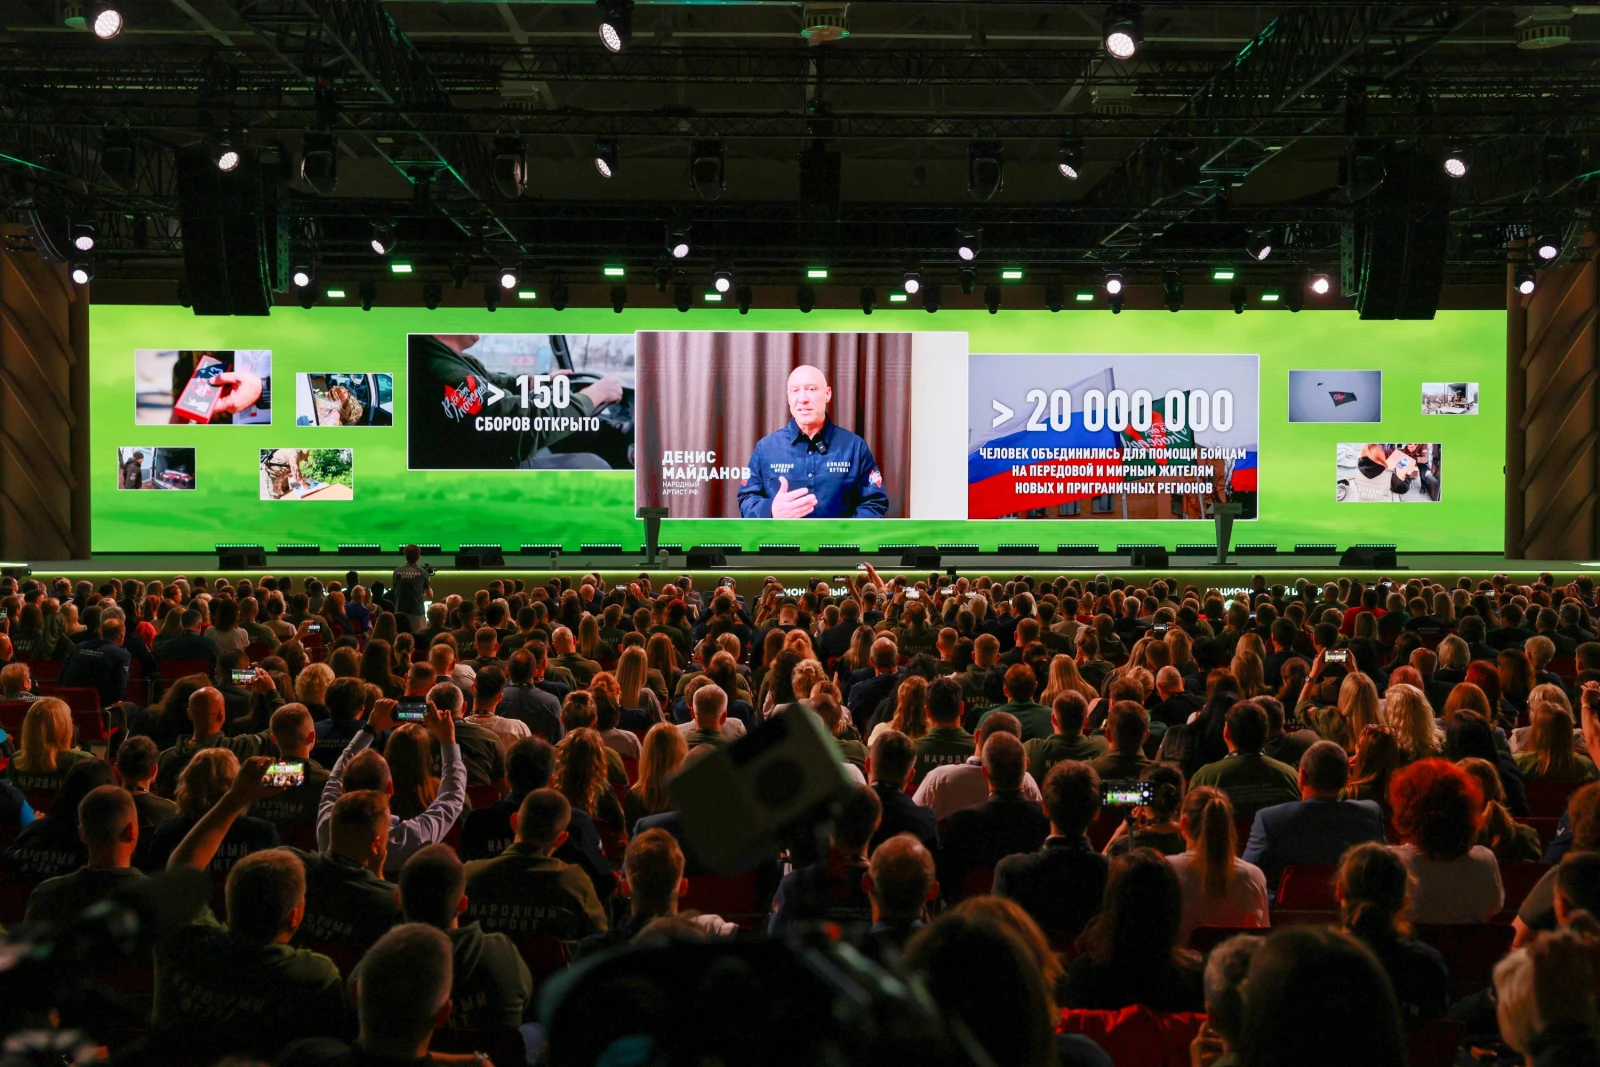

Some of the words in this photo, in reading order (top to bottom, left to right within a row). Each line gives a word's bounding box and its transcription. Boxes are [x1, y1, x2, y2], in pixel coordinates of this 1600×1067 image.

[516, 374, 570, 409] 150
[1026, 389, 1072, 432] 20
[1083, 389, 1153, 432] 000
[1164, 389, 1234, 432] 000
[475, 416, 531, 432] СБОРОВ
[534, 416, 600, 432] ОТКРЫТО
[662, 450, 716, 466] ДЕНИС
[980, 447, 1029, 460] ЧЕЛОВЕК
[1031, 447, 1120, 461] ОБЪЕДИНИЛИСЬ
[1122, 447, 1146, 461] ДЛЯ
[1149, 447, 1198, 461] ПОМОЩИ
[1200, 445, 1247, 461] БОЙЦАМ
[662, 464, 751, 482] МАЙДАНОВ
[1012, 465, 1027, 477] НА
[1029, 463, 1094, 479] ПЕРЕДОВОЙ
[1096, 465, 1104, 477] И
[1106, 465, 1156, 477] МИРНЫМ
[1158, 465, 1214, 477] ЖИТЕЛЯМ
[662, 480, 700, 488] НАРОДНЫЙ
[662, 488, 687, 496] АРТИСТ
[688, 488, 699, 496] РФ
[1015, 482, 1054, 494] НОВЫХ
[1056, 482, 1064, 494] И
[1066, 482, 1155, 494] ПРИГРАНИЧНЫХ
[1157, 482, 1213, 494] РЕГИОНОВ
